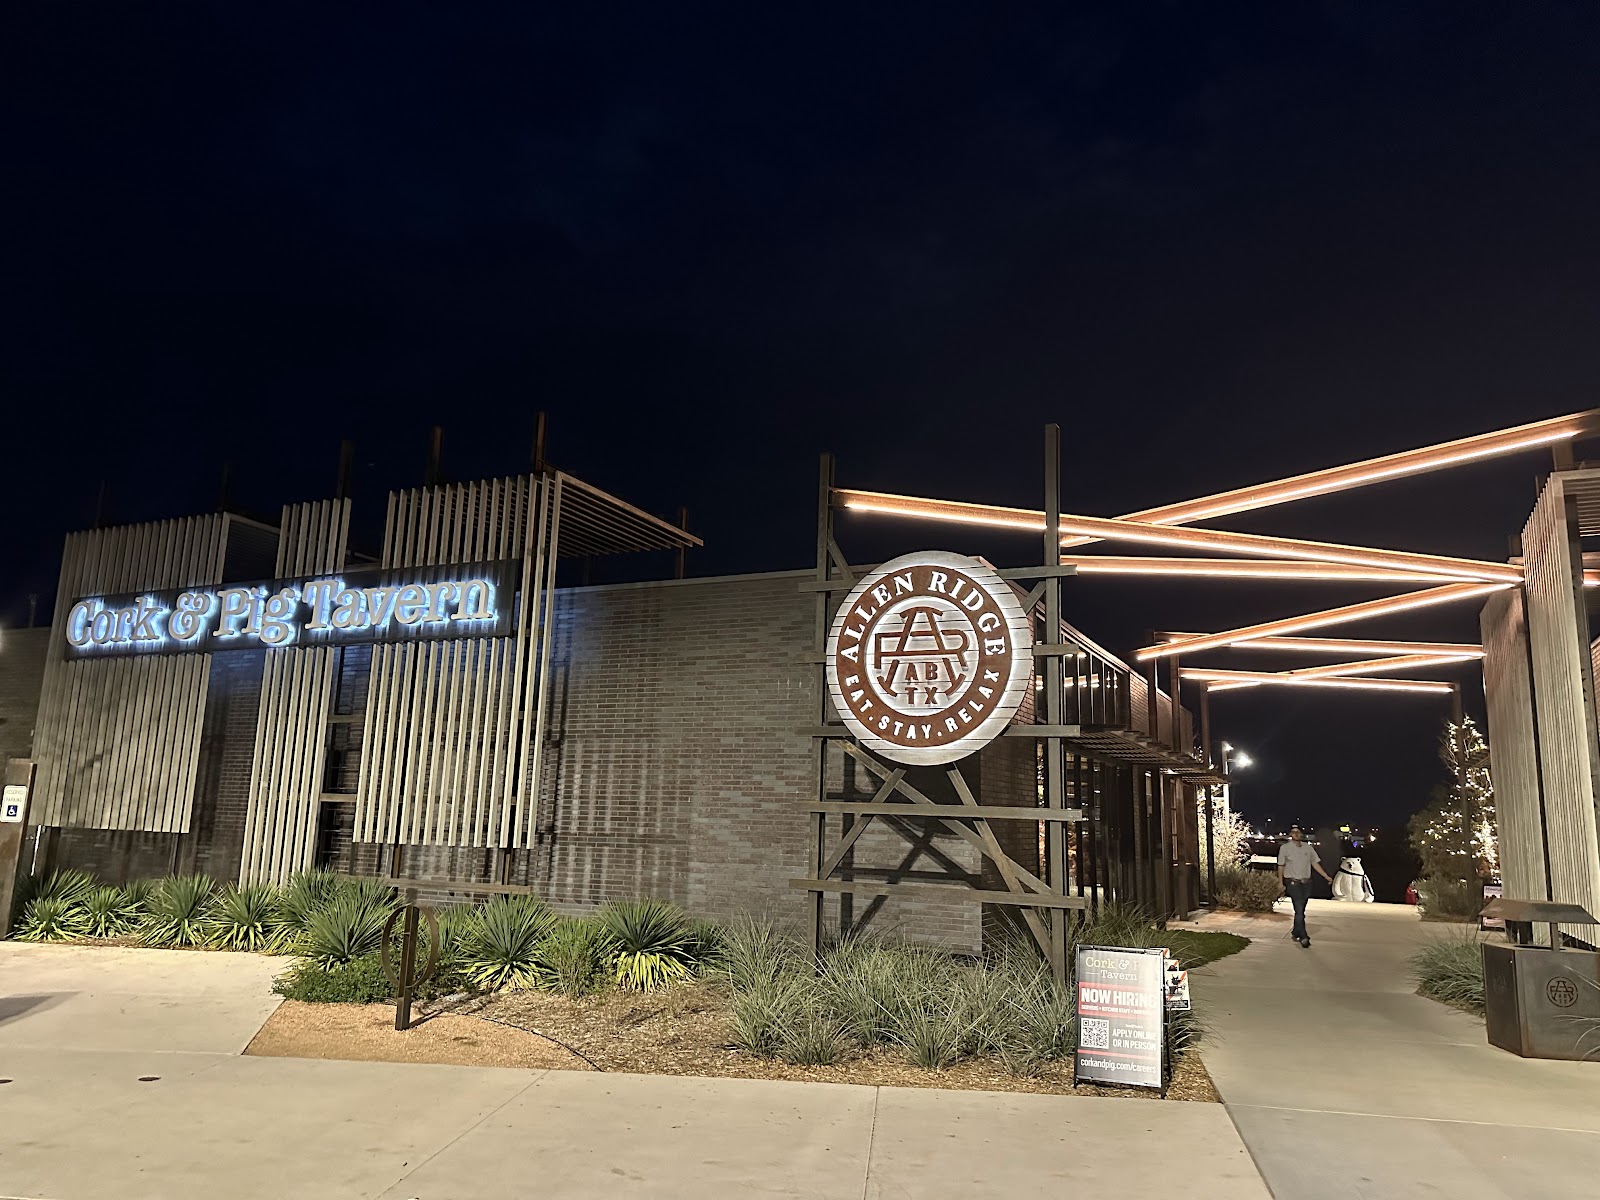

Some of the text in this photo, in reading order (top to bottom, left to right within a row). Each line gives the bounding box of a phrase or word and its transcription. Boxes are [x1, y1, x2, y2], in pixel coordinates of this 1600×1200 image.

[65, 578, 496, 647] Cork & Pig Tavern
[840, 571, 1006, 664] ALLEN RIDGE
[1085, 956, 1116, 970] Cork
[1118, 959, 1130, 970] &
[1100, 969, 1138, 981] Tavern
[1081, 987, 1112, 1005] NOW
[1112, 991, 1157, 1009] HIRING
[1112, 1028, 1158, 1041] APPLY ONLINE
[1112, 1038, 1157, 1051] OR IN PERSON
[1080, 1057, 1157, 1074] corkandpig.com/careers
